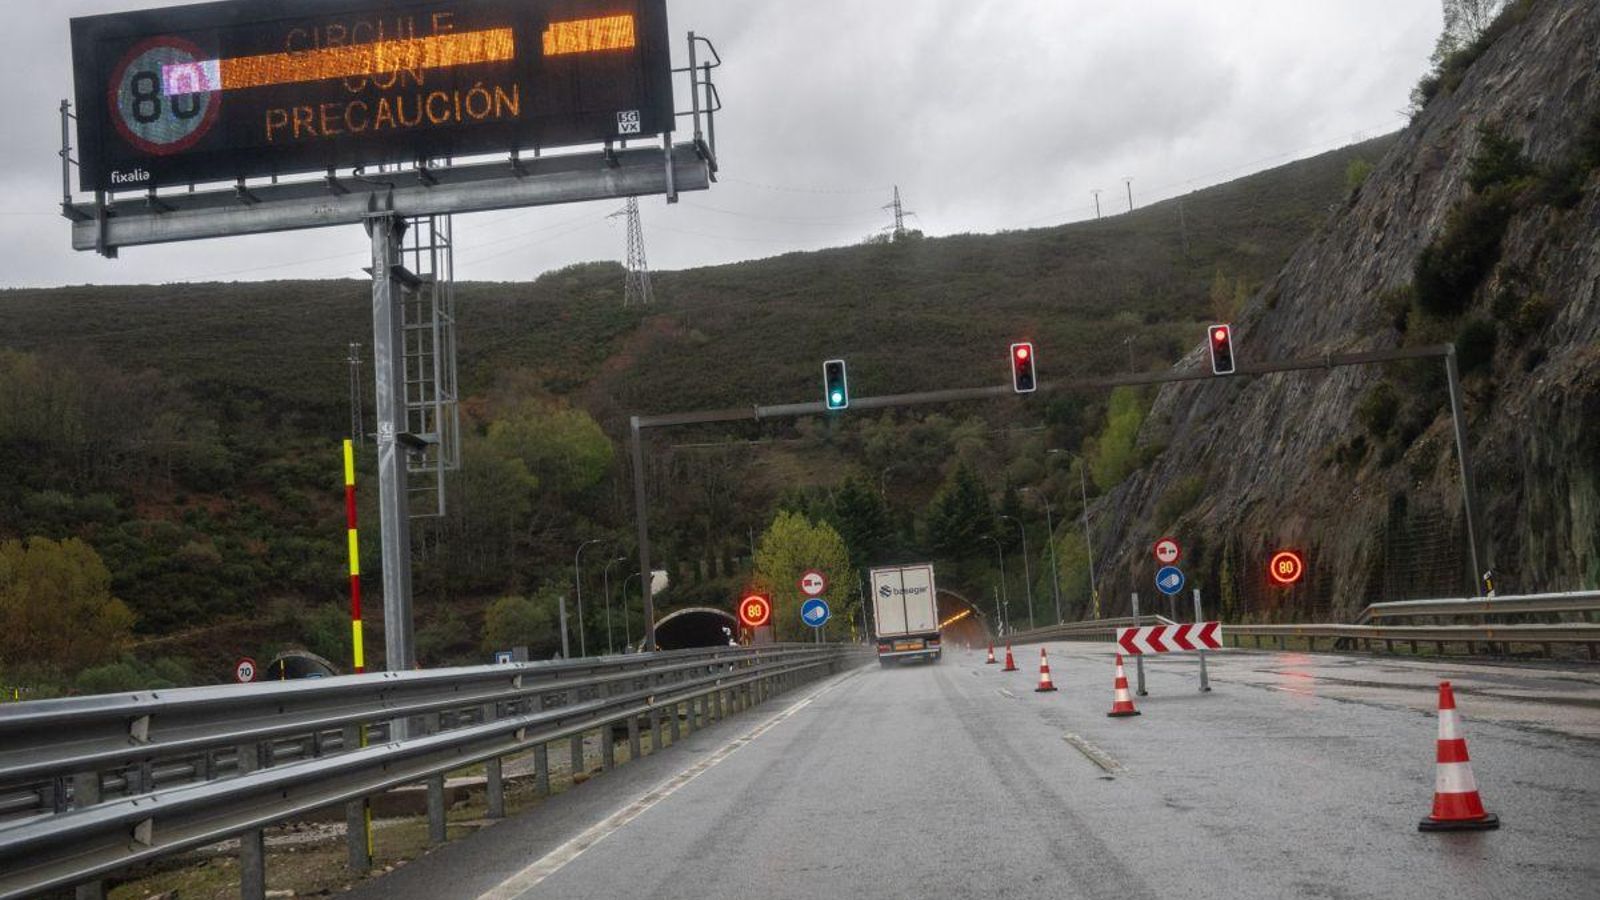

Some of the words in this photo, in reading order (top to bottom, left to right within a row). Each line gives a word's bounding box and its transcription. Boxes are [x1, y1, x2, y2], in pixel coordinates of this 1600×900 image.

[131, 67, 201, 124] 80
[265, 81, 520, 143] PRECAUCIÓN
[1279, 561, 1293, 574] 80
[748, 604, 762, 617] 80
[240, 667, 251, 677] 70
